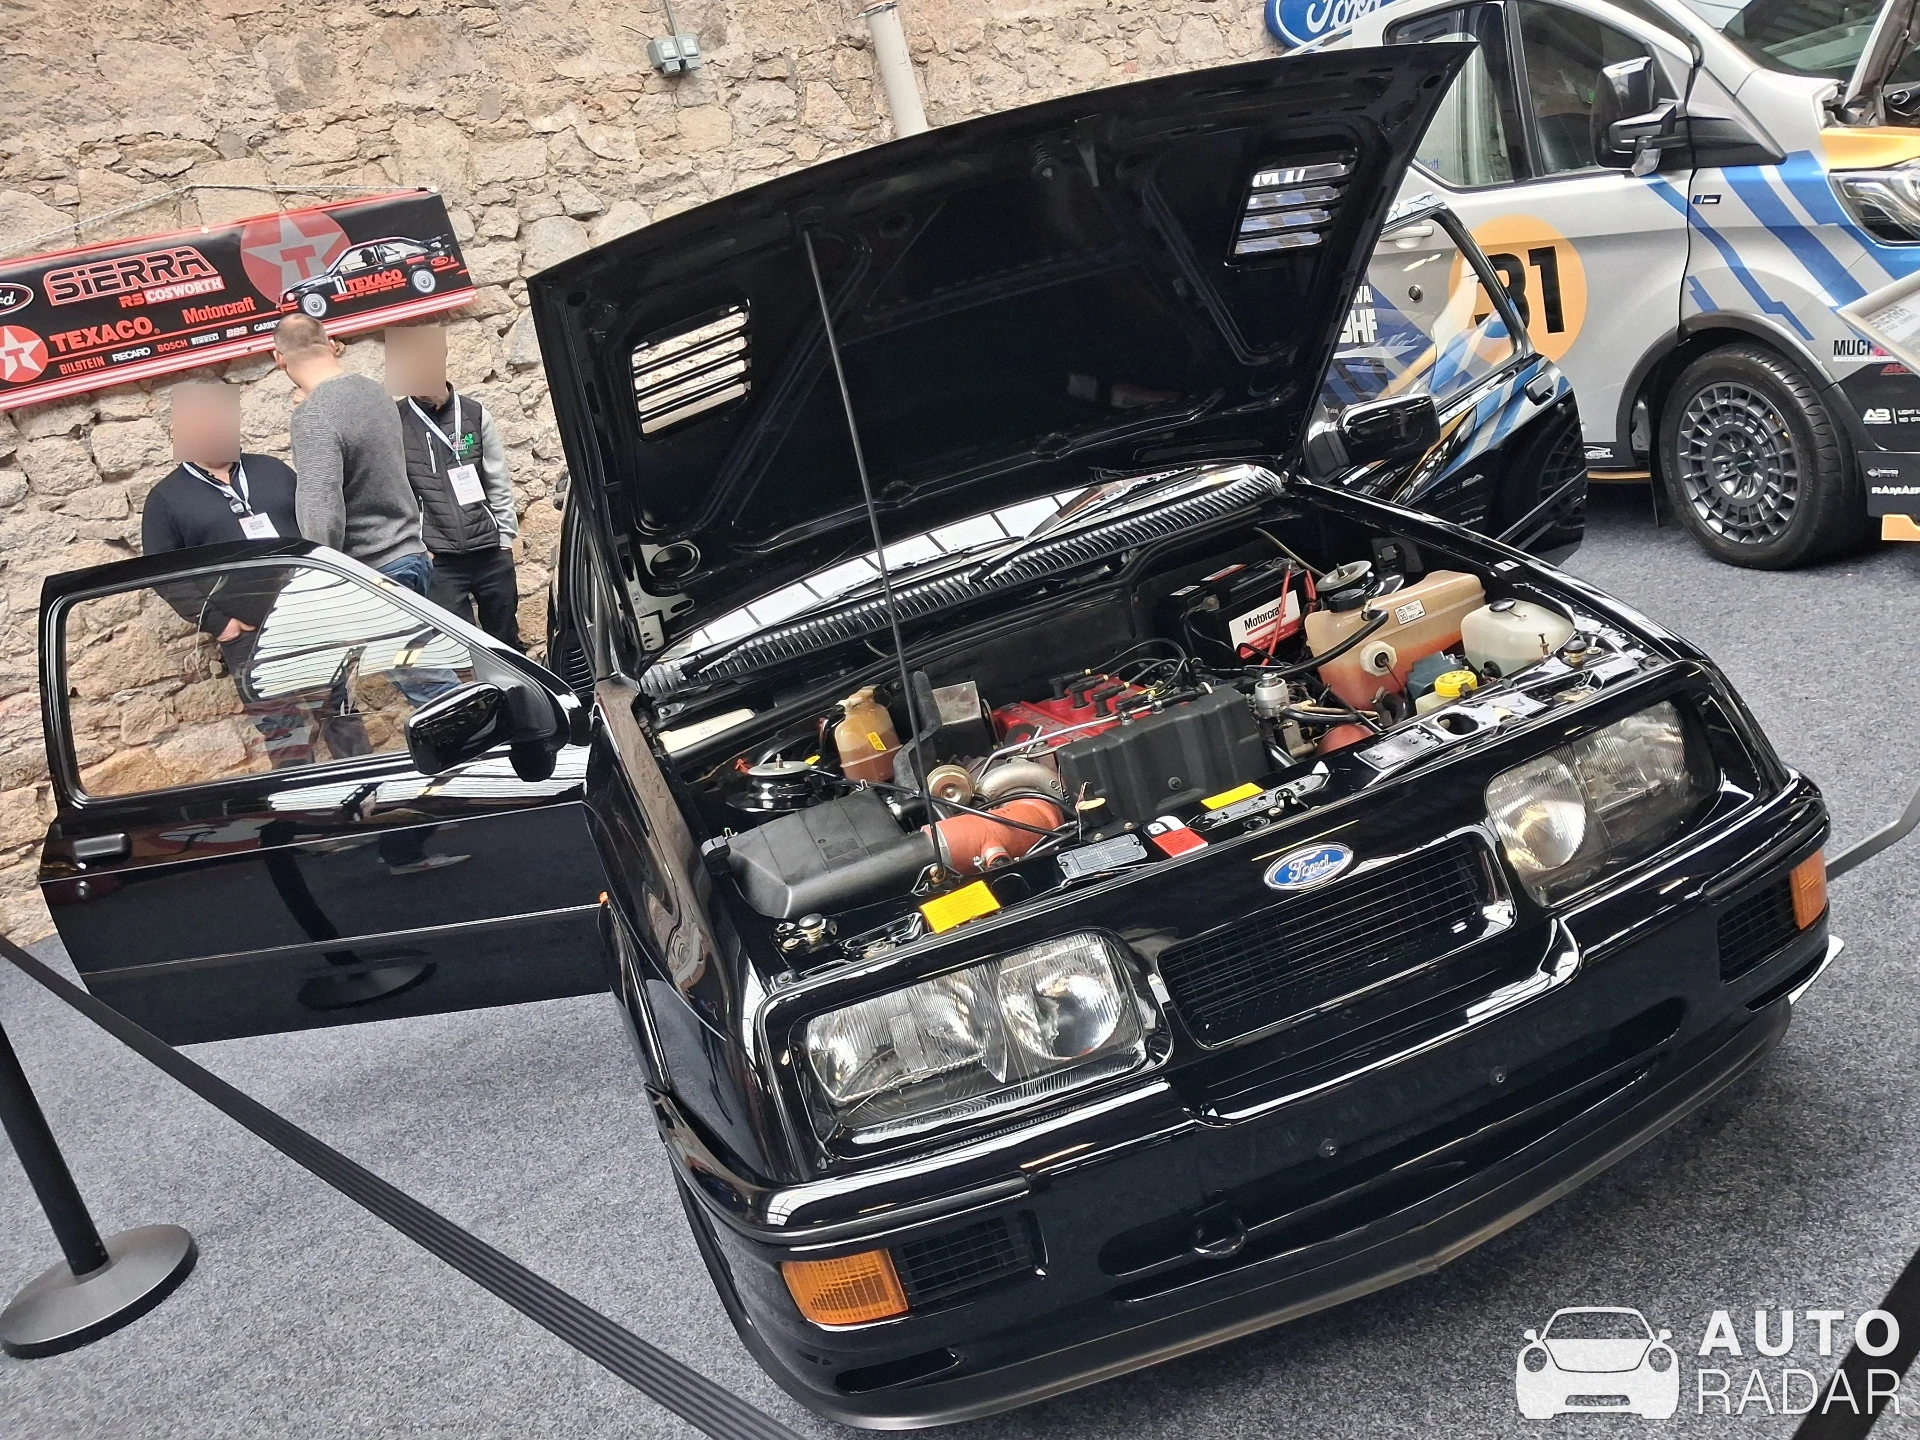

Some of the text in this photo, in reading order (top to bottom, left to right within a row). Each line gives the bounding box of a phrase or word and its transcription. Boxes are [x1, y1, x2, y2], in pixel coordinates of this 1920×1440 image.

[119, 278, 224, 308] RS COSWORTH
[345, 269, 403, 292] TEXACO
[182, 296, 256, 324] Motorcraft
[49, 316, 153, 352] TEXACO
[59, 356, 105, 375] BILSTEIN
[112, 347, 151, 362] RECARO
[157, 339, 188, 352] BOSCH
[226, 326, 248, 338] BBS
[254, 320, 281, 331] GARRE
[1243, 602, 1282, 631] Motorcra
[1288, 853, 1332, 881] Ford
